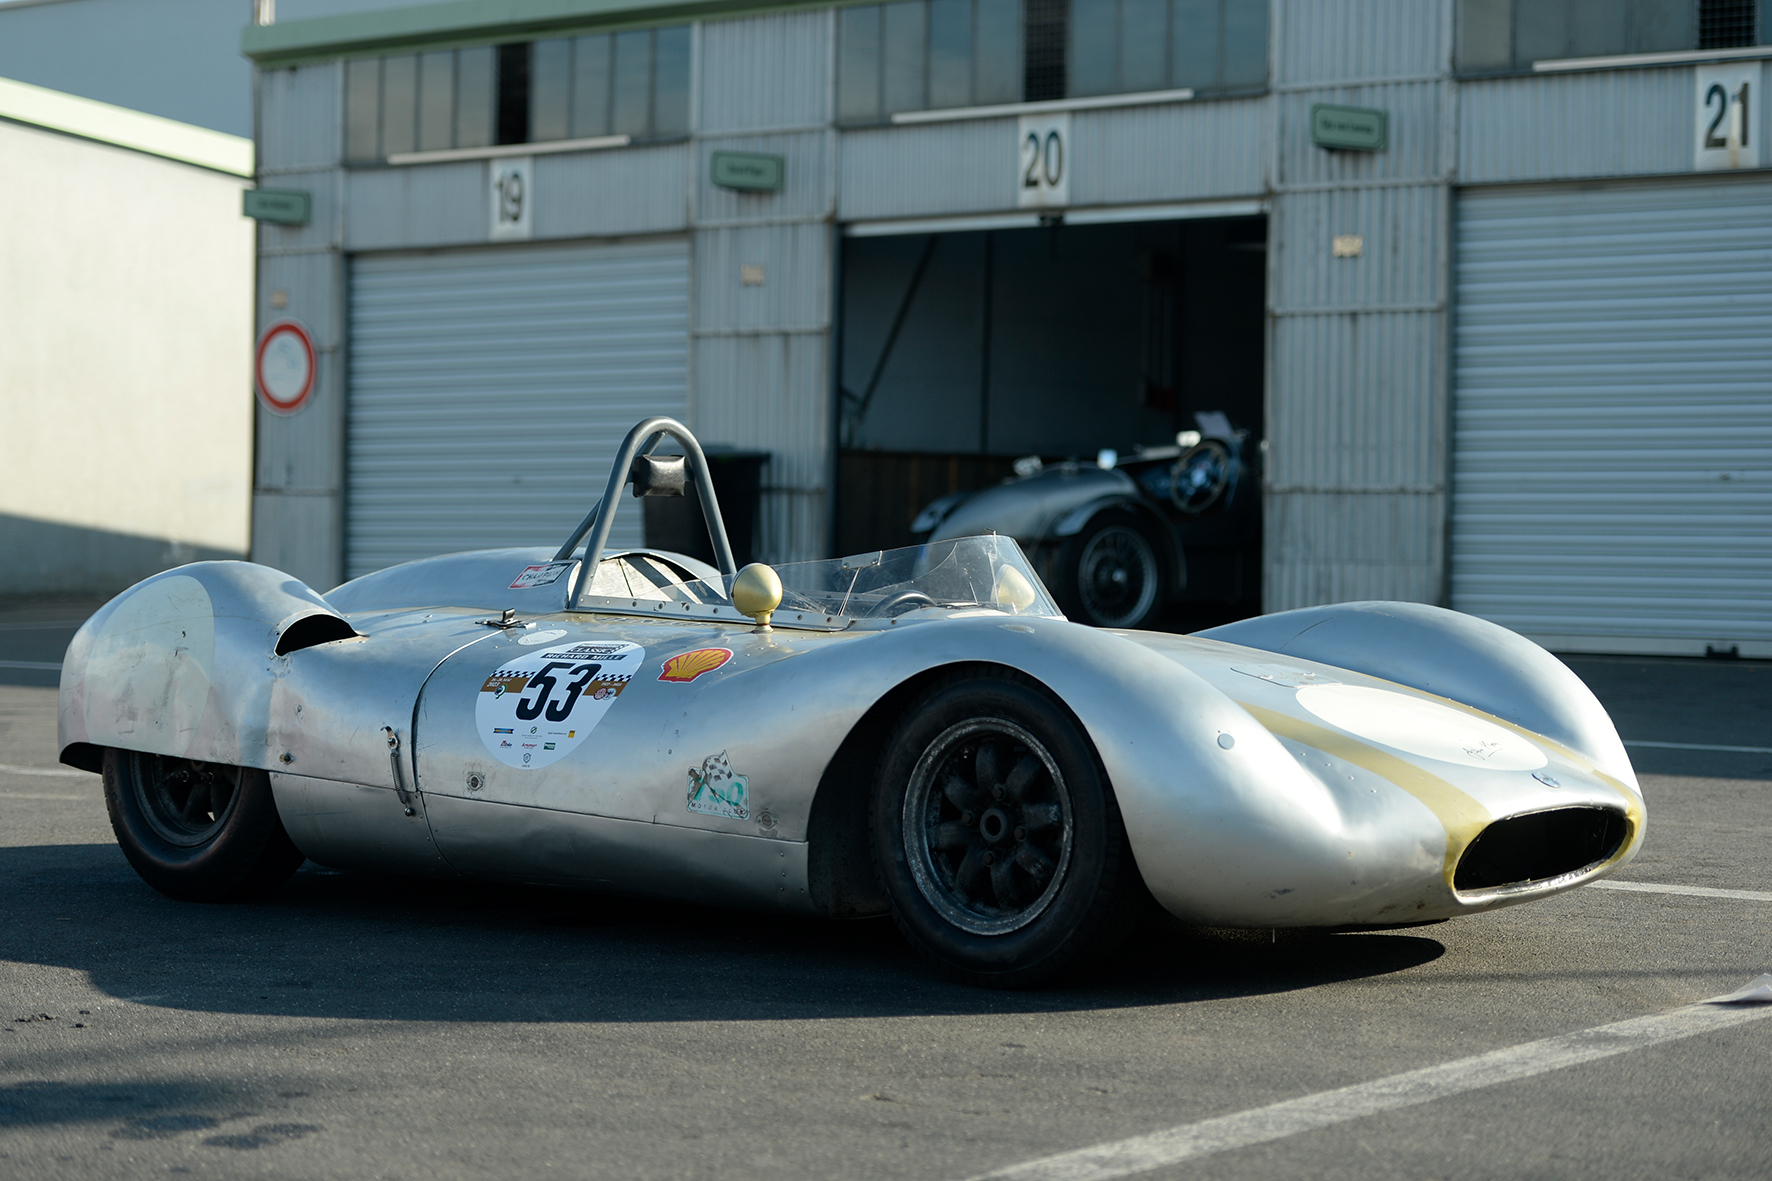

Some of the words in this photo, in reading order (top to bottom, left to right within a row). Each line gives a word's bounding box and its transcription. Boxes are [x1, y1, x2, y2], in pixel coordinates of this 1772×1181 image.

[1704, 82, 1749, 149] 21
[1022, 130, 1062, 189] 20
[494, 170, 524, 223] 19
[516, 662, 602, 722] 53
[691, 802, 718, 811] MOTOR
